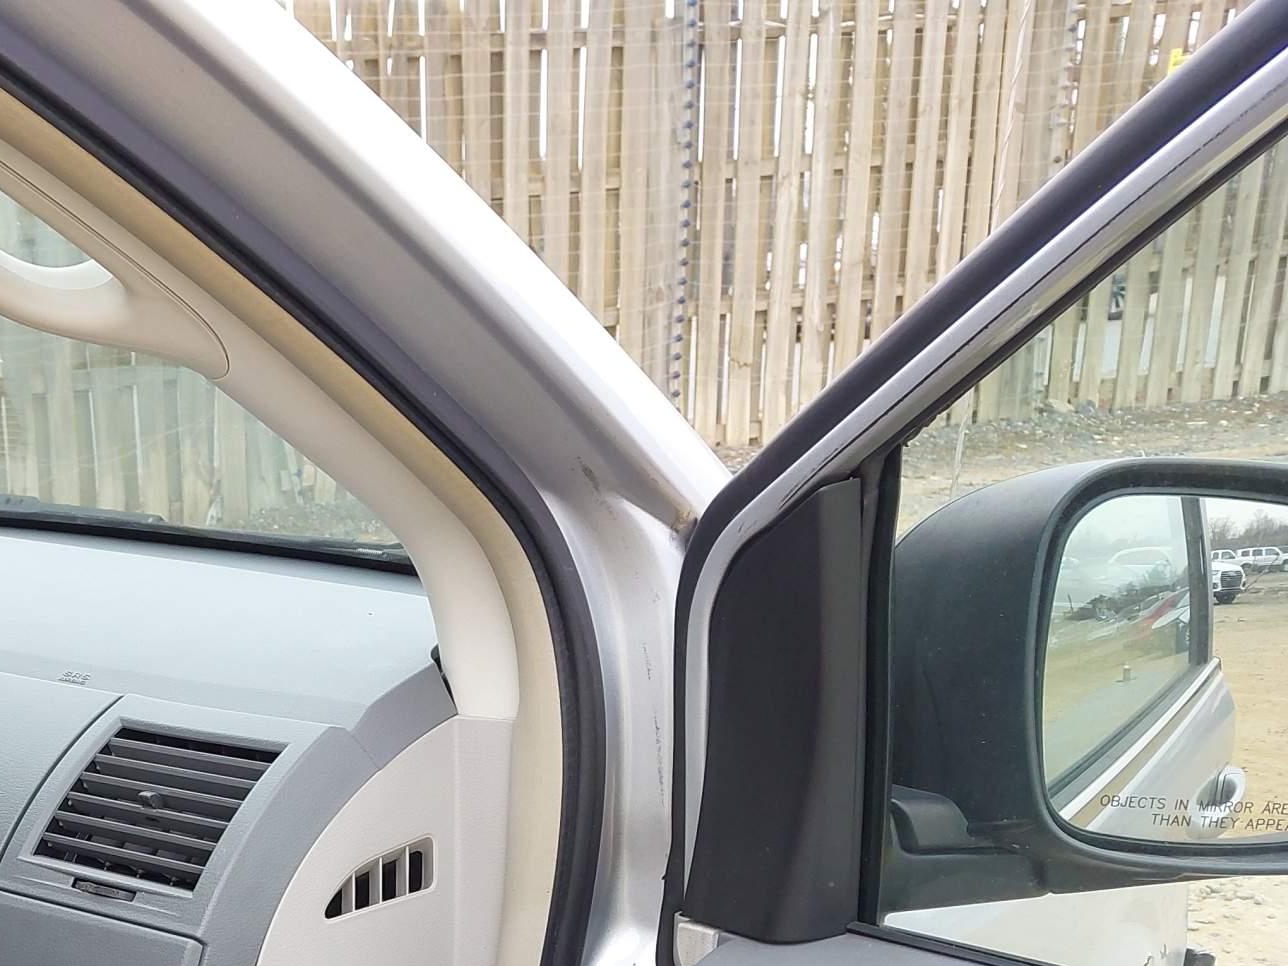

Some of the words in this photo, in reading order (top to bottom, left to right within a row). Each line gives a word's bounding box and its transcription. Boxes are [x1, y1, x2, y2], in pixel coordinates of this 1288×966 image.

[1100, 794, 1167, 810] OBJECTS
[1174, 798, 1190, 811] IN
[1198, 800, 1254, 814] MIRROR
[1262, 801, 1288, 816] ARE
[1151, 813, 1192, 827] THAN
[1200, 815, 1240, 829] THEY
